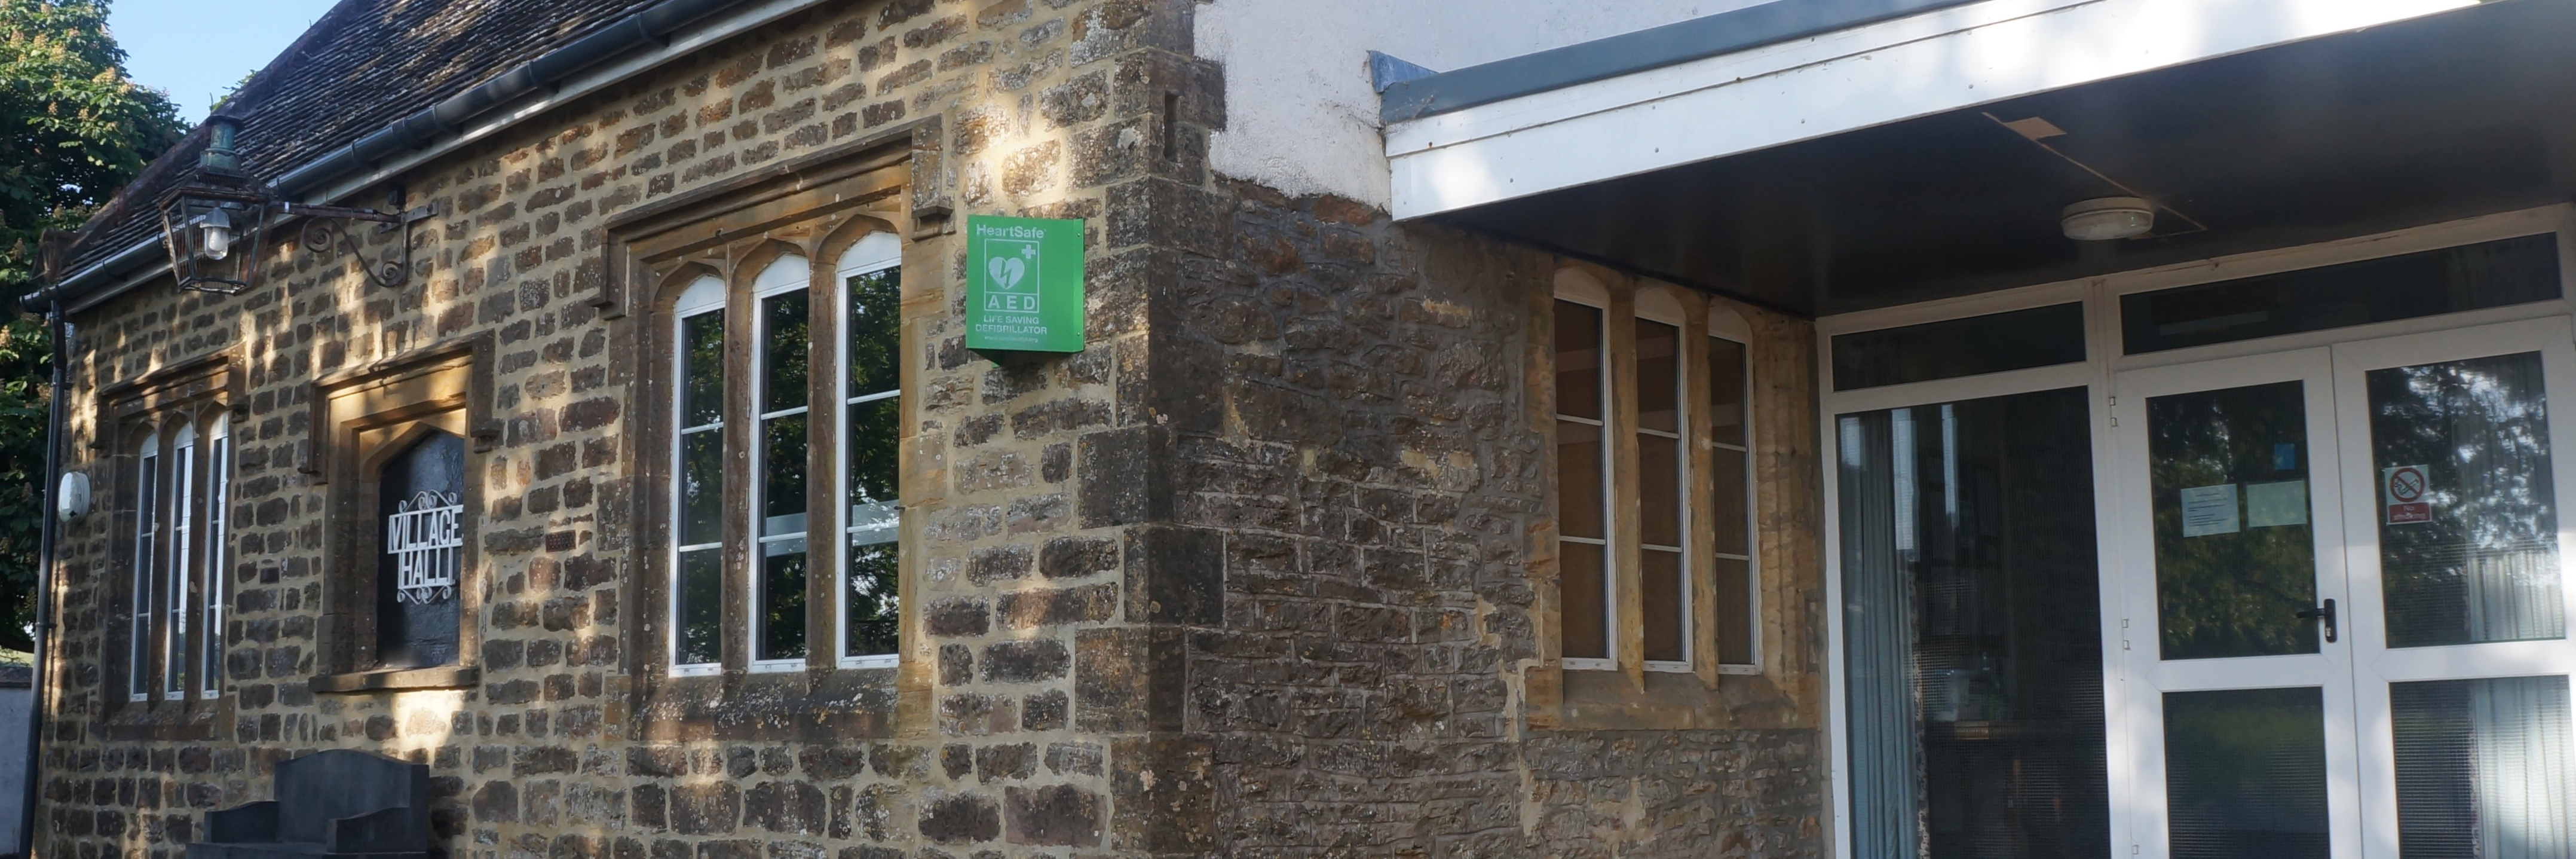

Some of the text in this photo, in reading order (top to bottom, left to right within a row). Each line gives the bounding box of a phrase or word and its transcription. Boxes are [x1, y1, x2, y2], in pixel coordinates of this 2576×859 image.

[976, 224, 1045, 239] HeartSafe
[1006, 316, 1039, 324] SAVING
[975, 324, 1047, 334] DEFIBRILLATOR
[392, 508, 462, 551] VILLAGE
[401, 548, 448, 586] HALL
